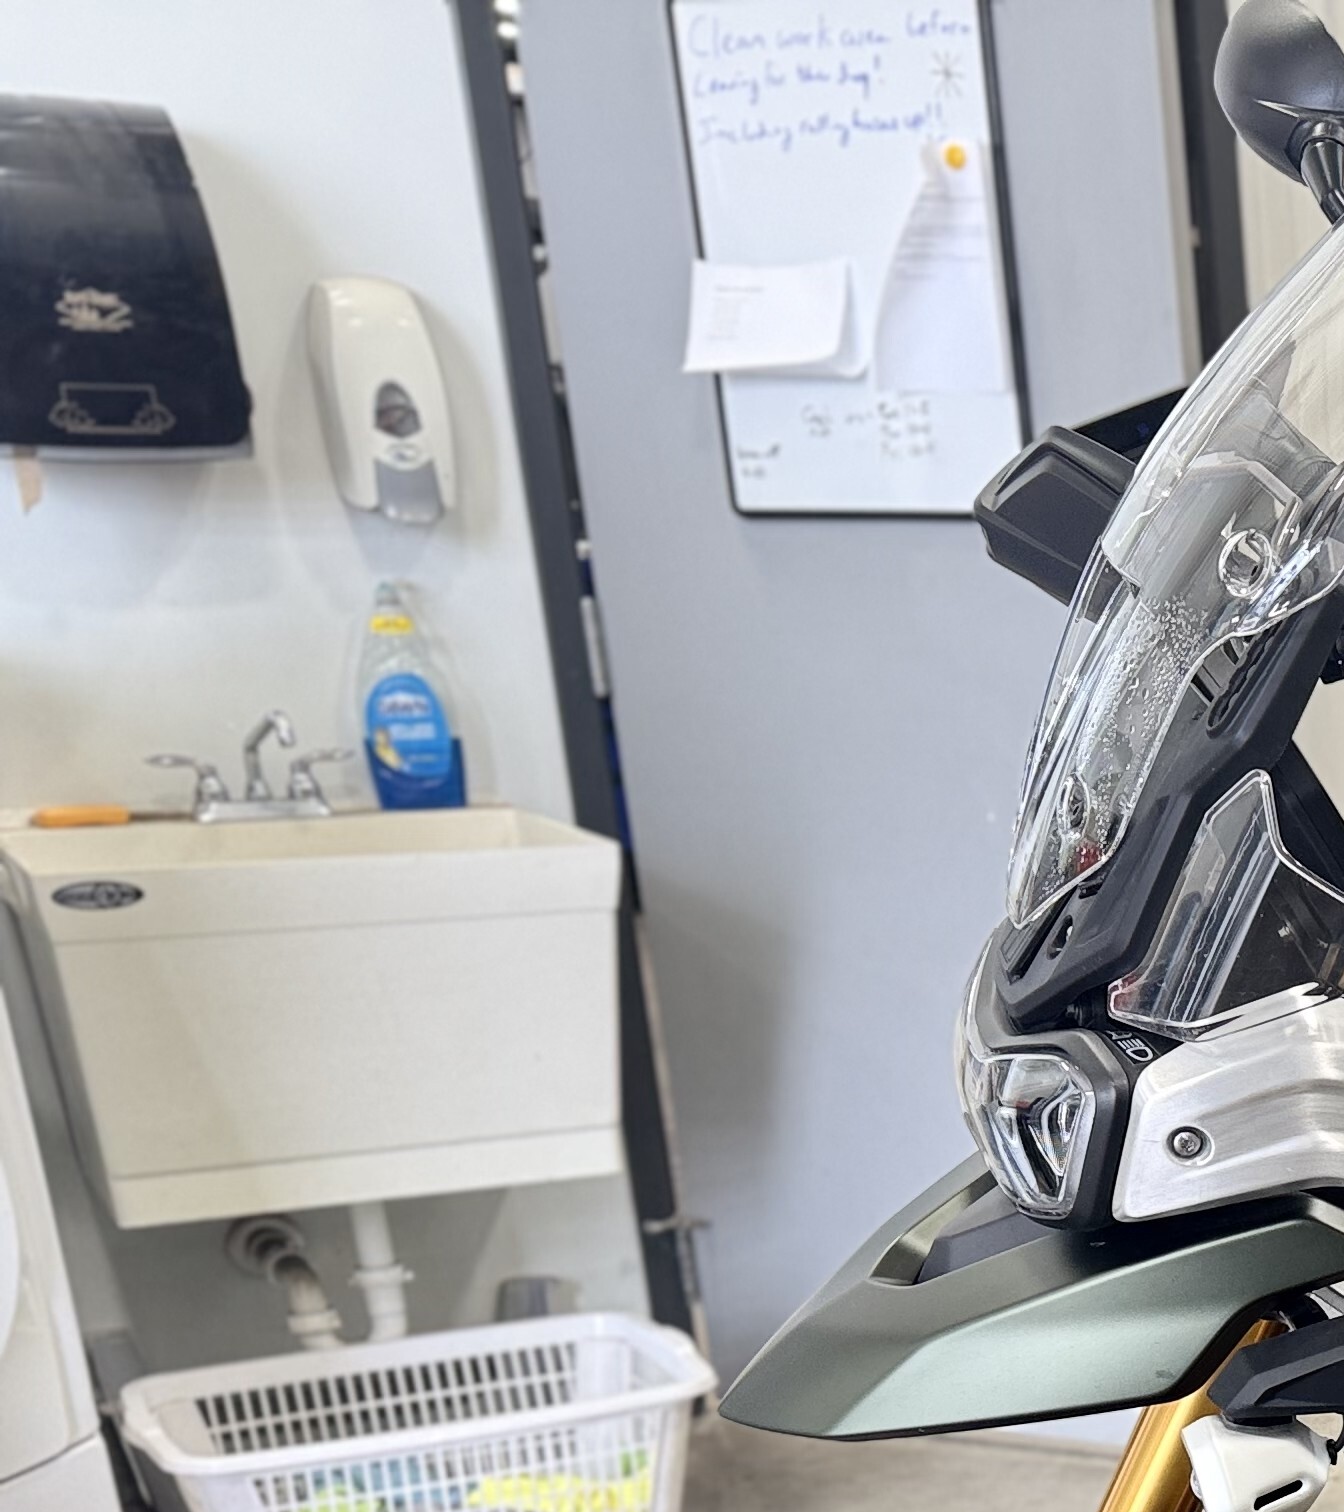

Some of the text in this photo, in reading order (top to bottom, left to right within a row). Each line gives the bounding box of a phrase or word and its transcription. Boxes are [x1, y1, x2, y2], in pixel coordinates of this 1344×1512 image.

[687, 13, 765, 58] Clean
[776, 14, 834, 50] work
[905, 8, 971, 38] before
